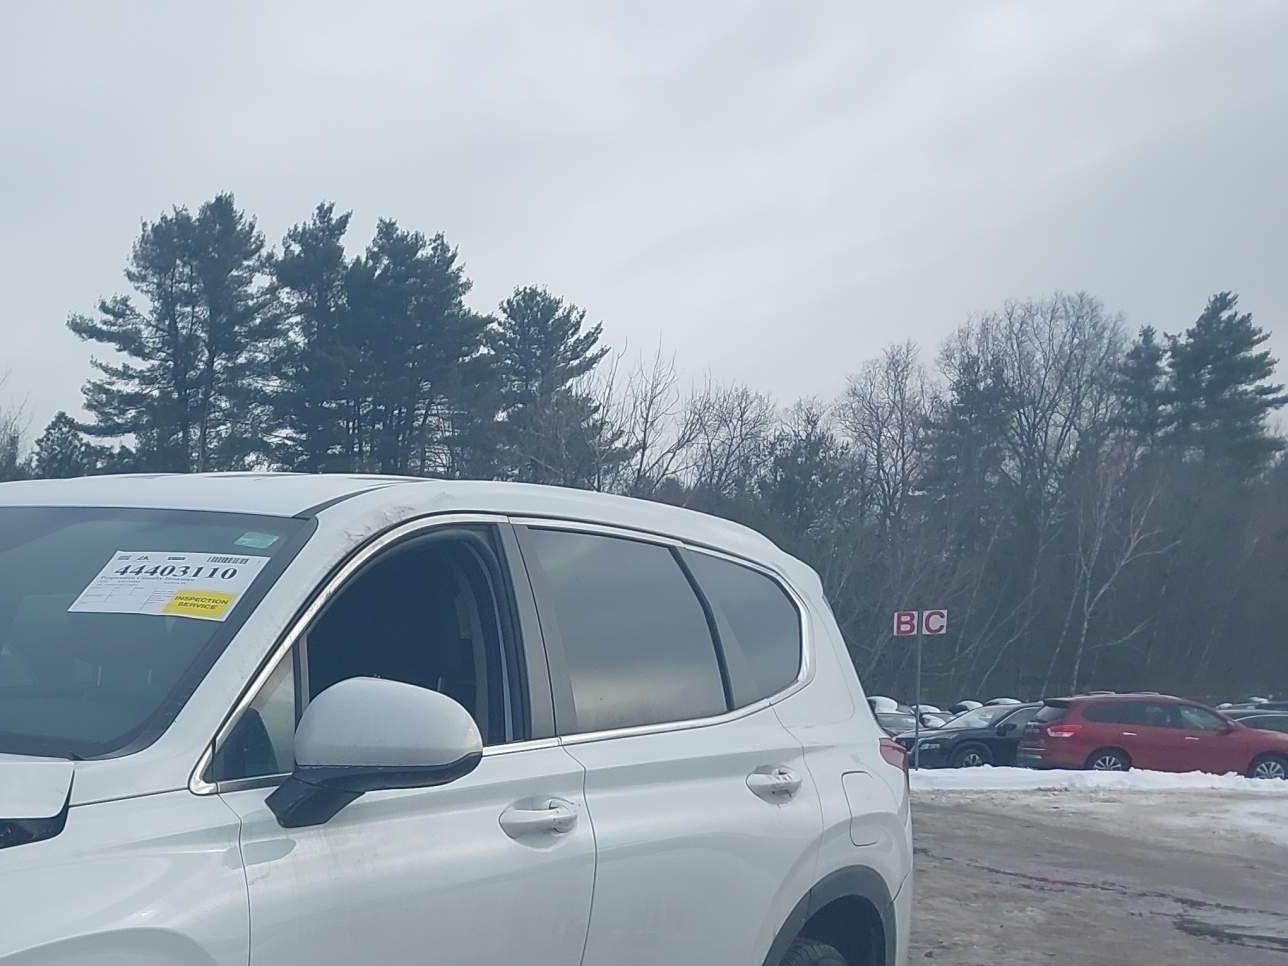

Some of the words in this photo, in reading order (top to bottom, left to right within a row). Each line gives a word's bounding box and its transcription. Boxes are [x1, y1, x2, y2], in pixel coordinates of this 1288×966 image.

[114, 564, 238, 580] 44403110
[175, 595, 229, 605] INSPECTION
[178, 601, 218, 610] SERVICE
[897, 612, 916, 635] B
[924, 610, 945, 634] C
